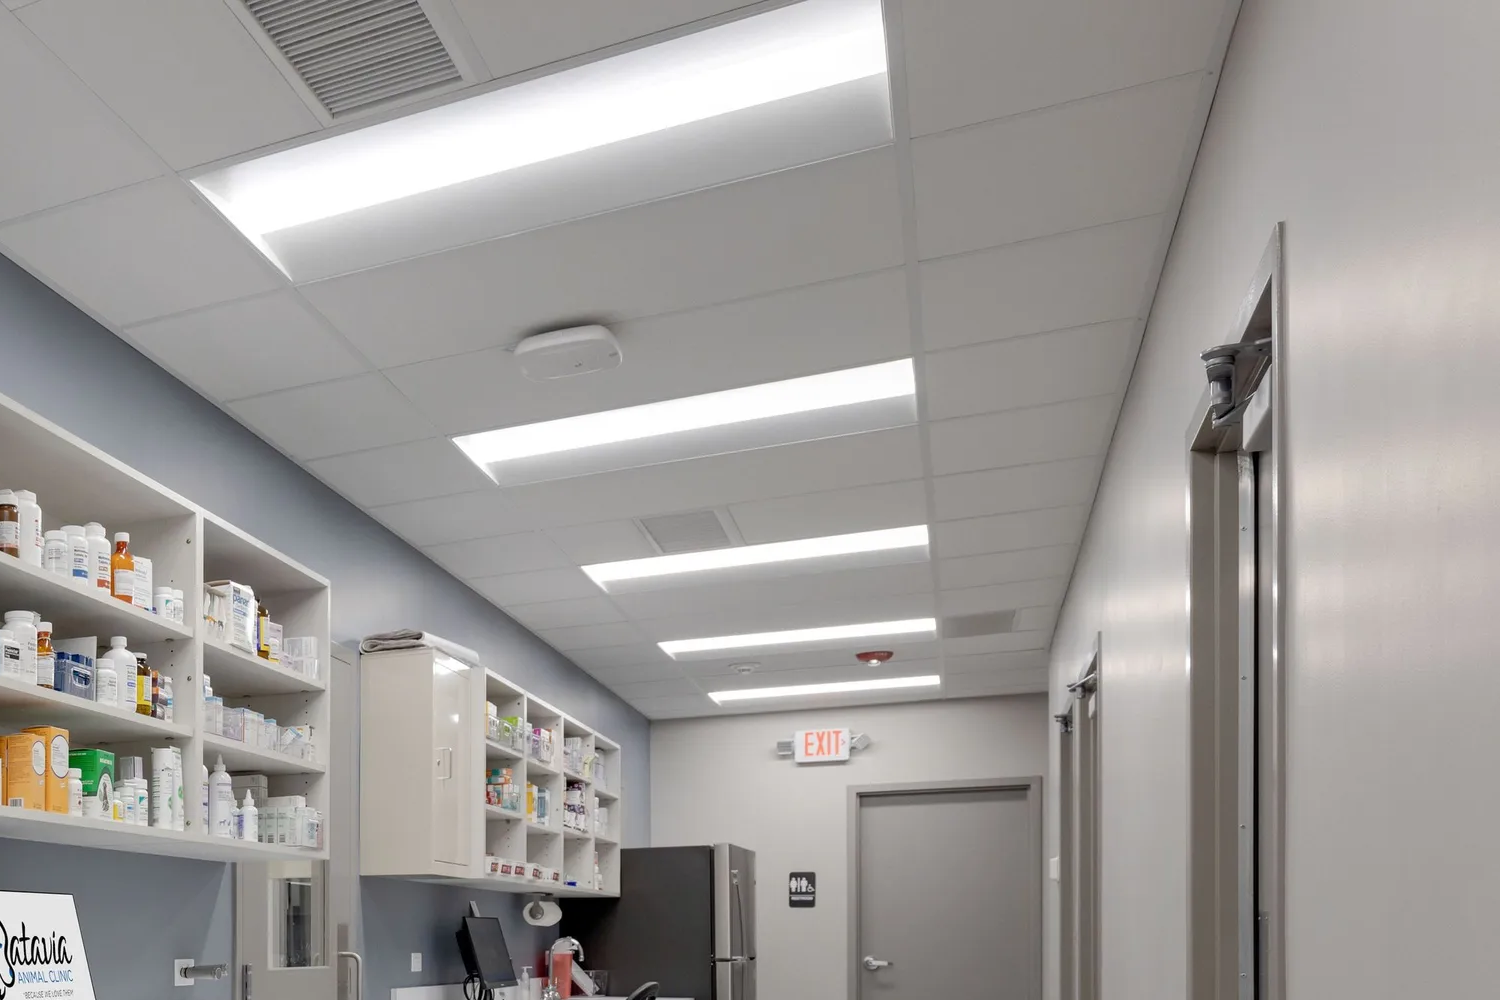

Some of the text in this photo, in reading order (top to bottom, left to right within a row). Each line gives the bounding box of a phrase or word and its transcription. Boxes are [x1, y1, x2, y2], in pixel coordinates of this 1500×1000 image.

[804, 730, 842, 756] EXIT
[18, 969, 74, 984] ANIMAL CLINIC
